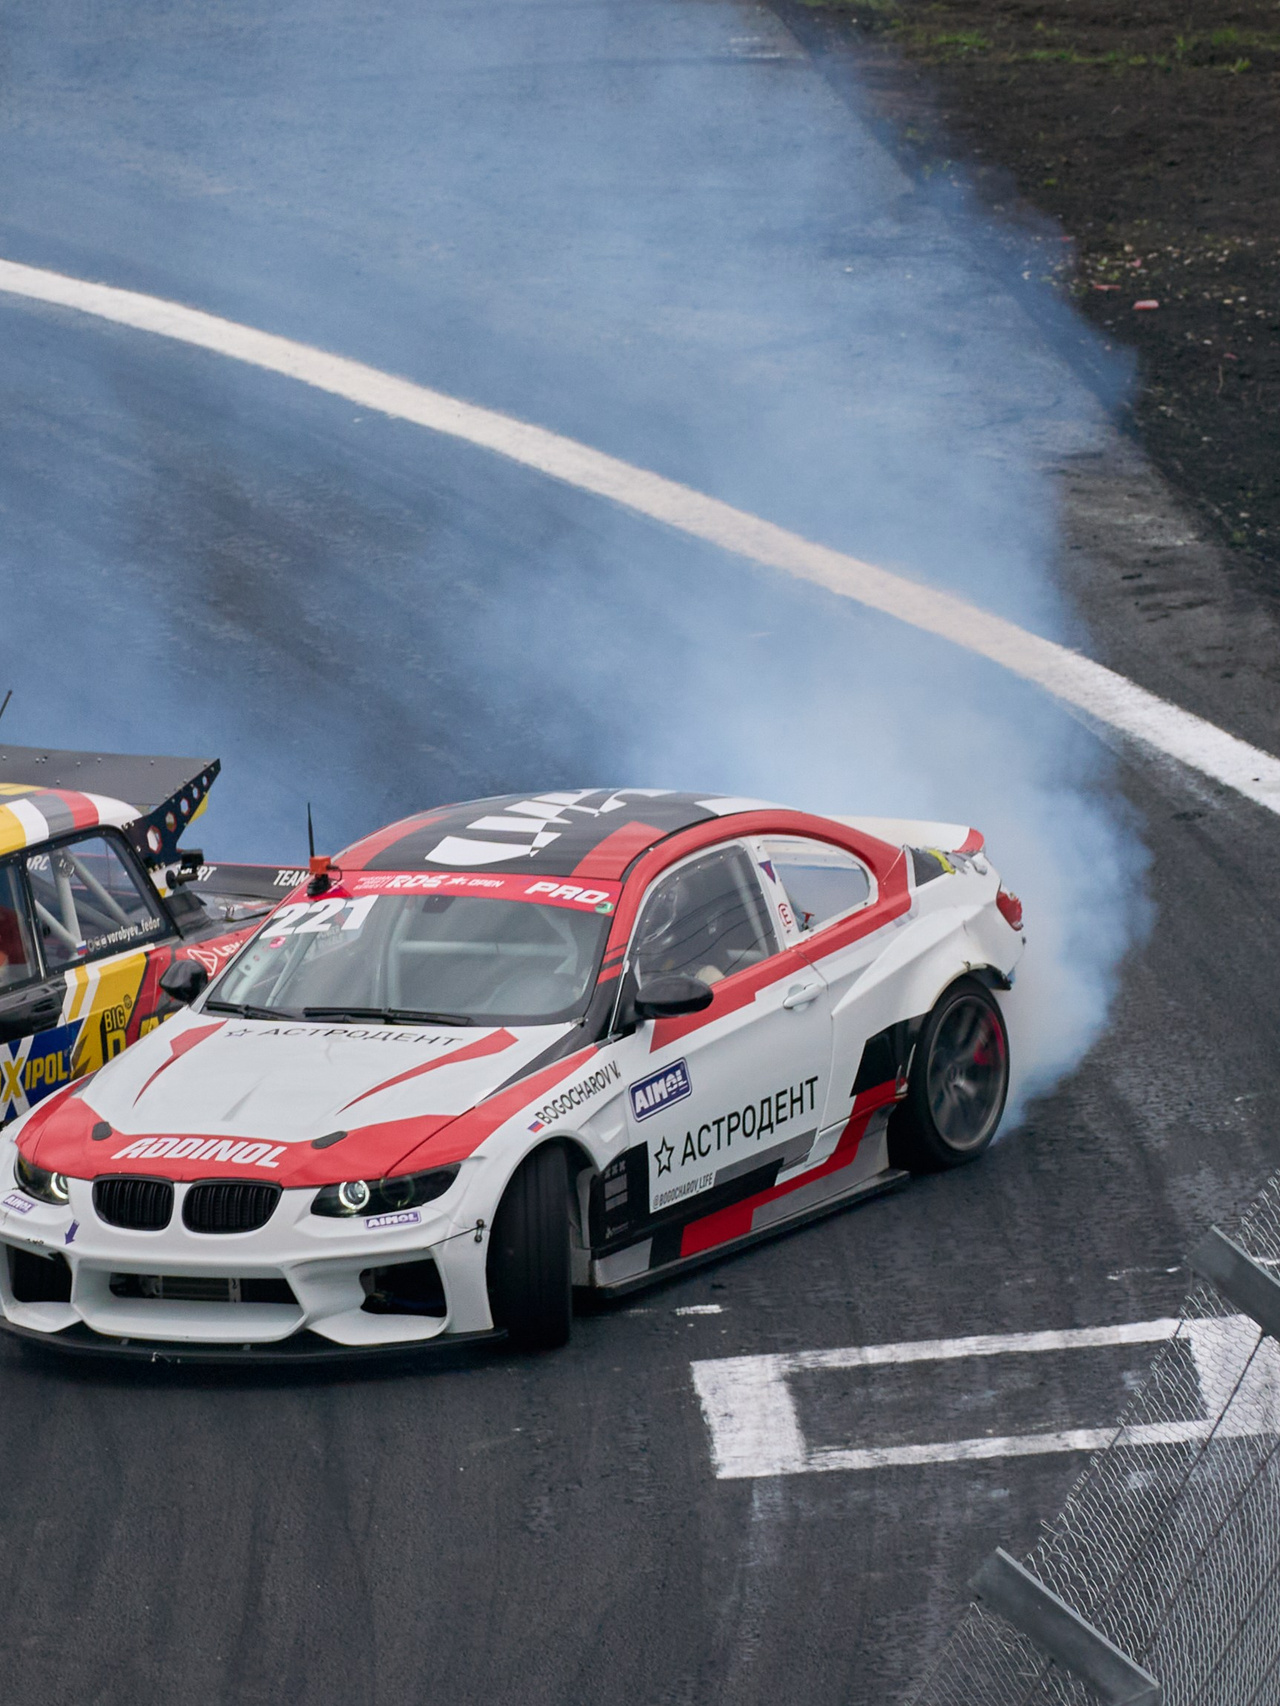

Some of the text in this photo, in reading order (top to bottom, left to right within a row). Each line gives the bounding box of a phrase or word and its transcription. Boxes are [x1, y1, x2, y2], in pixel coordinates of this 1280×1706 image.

[385, 874, 450, 889] RDS
[523, 880, 611, 905] PRO
[258, 893, 380, 940] 221
[103, 1004, 126, 1032] BIG
[257, 1027, 464, 1048] АСТРОДЕНТ
[535, 1066, 612, 1125] BOGOCHAROV
[634, 1068, 689, 1115] AIMOL
[681, 1075, 819, 1166] АСТРОДЕНТ
[110, 1137, 288, 1169] ADDINOL
[366, 1211, 420, 1229] AIMOL
